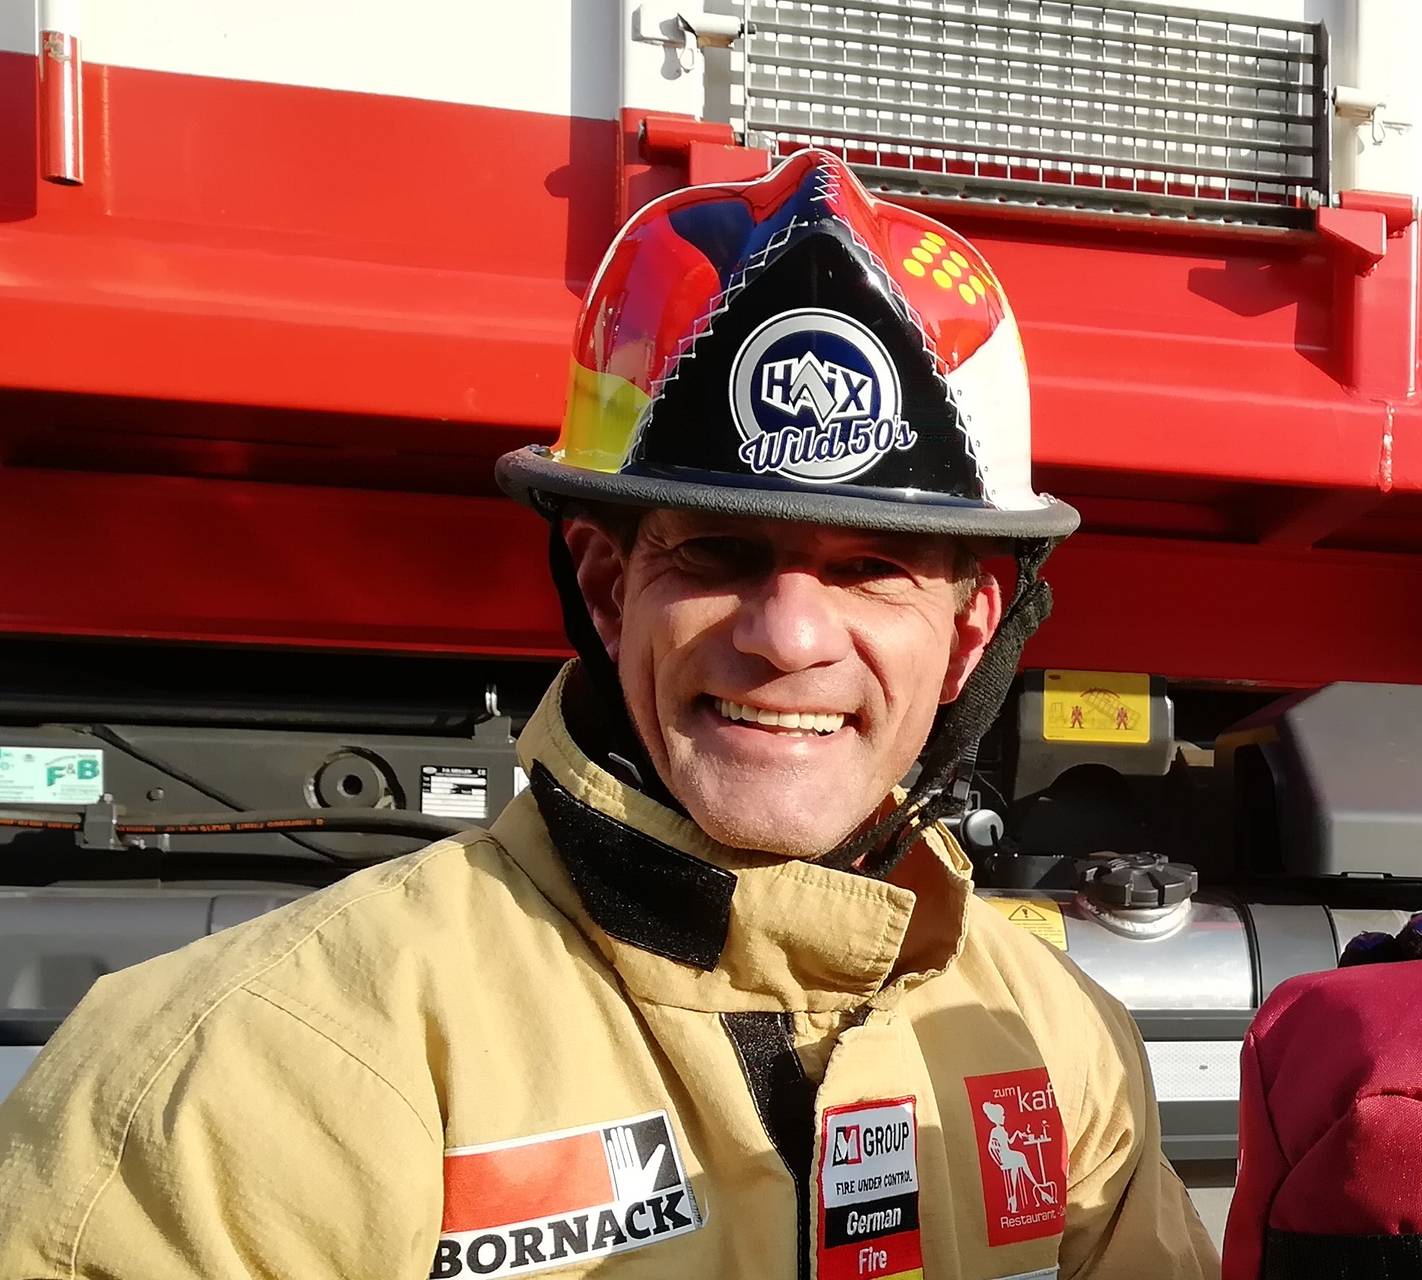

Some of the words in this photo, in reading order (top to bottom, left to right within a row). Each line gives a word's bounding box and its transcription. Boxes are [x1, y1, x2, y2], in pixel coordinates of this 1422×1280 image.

[740, 423, 845, 473] Wild
[849, 414, 917, 455] 50's
[46, 758, 100, 788] F&B
[992, 1086, 1016, 1099] zum
[863, 1121, 910, 1157] GROUP
[836, 1180, 857, 1196] FIRE
[857, 1175, 882, 1193] UNDER
[883, 1169, 913, 1188] CONTROL
[846, 1207, 902, 1236] German
[1000, 1208, 1057, 1229] Restaurant
[429, 1189, 693, 1280] BORNACK
[858, 1246, 888, 1275] Fire
